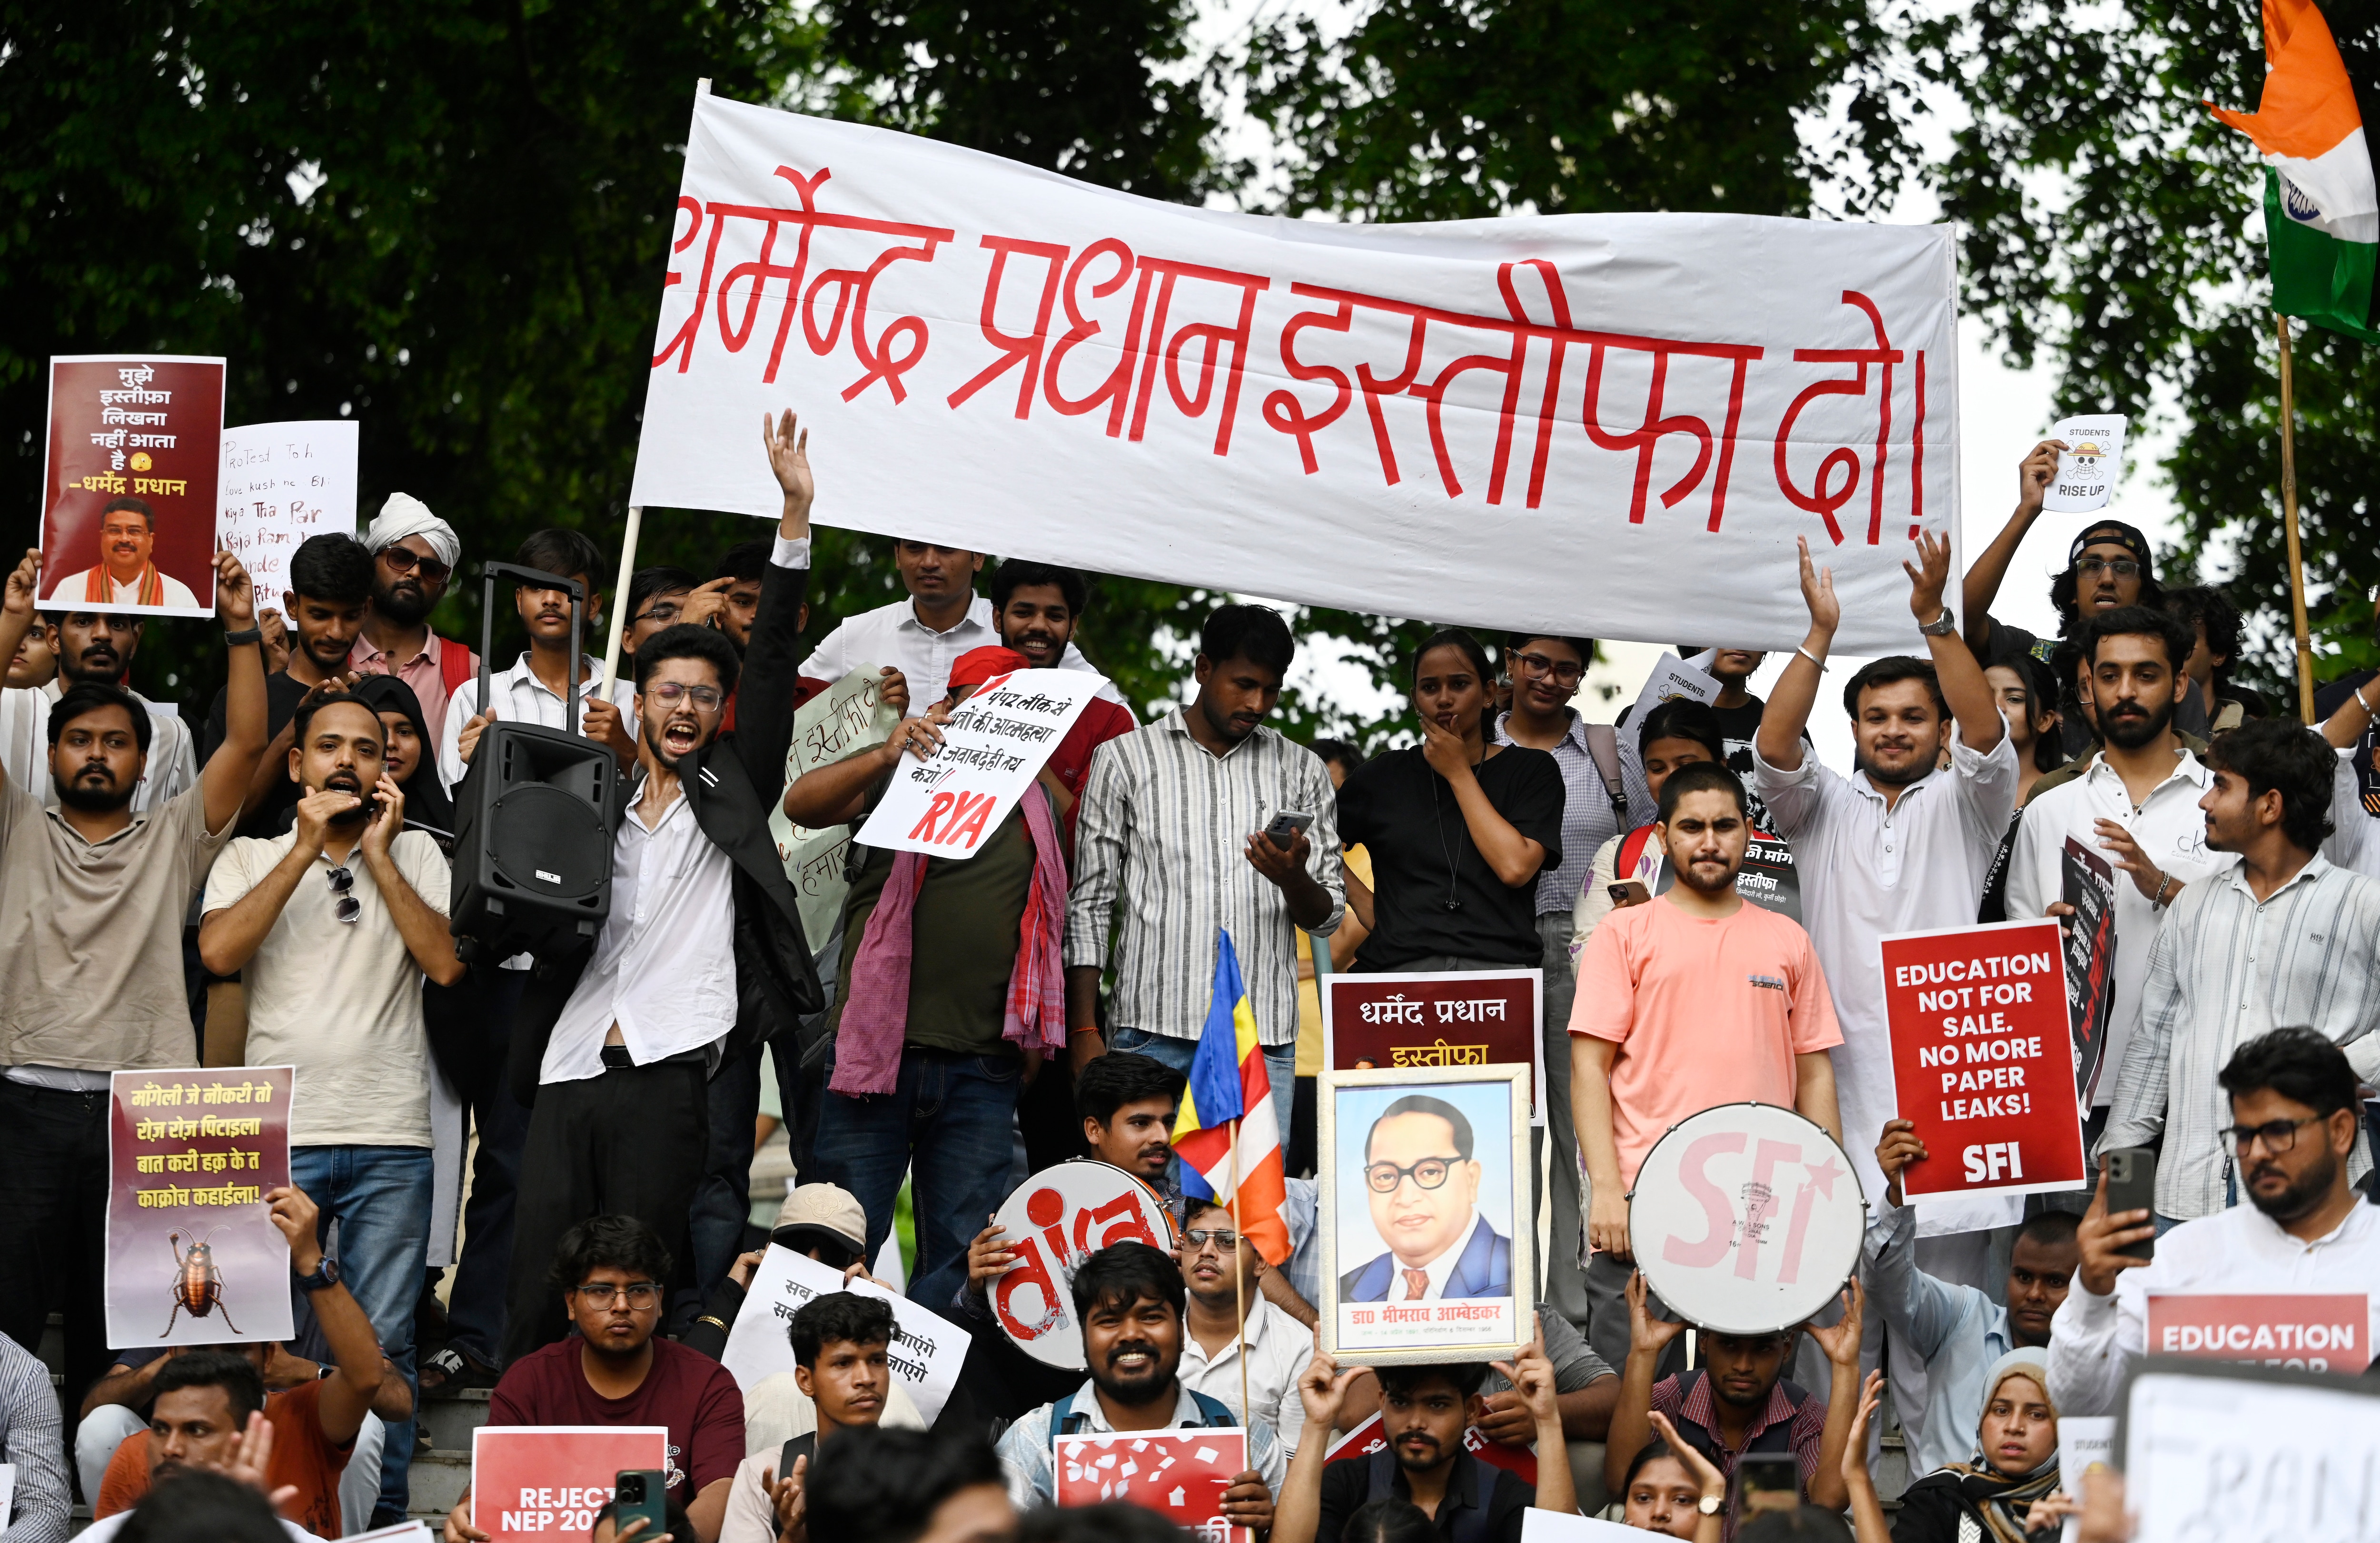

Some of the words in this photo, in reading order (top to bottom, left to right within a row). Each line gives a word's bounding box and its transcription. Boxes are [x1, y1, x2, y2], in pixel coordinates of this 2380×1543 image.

[947, 238, 1270, 457] प्रधान
[119, 365, 154, 387] मुझे
[100, 386, 171, 406] इस्तीफ़ा
[101, 407, 167, 425] लिखना
[90, 429, 128, 448] नहीं
[129, 434, 177, 448] आता
[110, 450, 126, 470] है
[134, 477, 187, 496] प्रधान
[2059, 485, 2087, 496] RISE
[2089, 485, 2104, 496] UP
[252, 502, 277, 518] Tha
[290, 501, 322, 524] Par
[258, 527, 290, 545] Ram
[1669, 673, 1705, 697] STUDENTS
[972, 711, 994, 733] की
[908, 790, 997, 850] RYA
[1737, 872, 1778, 891] इस्तीफा
[1895, 952, 2050, 987] EDUCATION
[1919, 988, 1973, 1012] NOT
[1980, 982, 2032, 1008] FOR
[1434, 999, 1507, 1023] प्रधान
[1943, 1012, 2013, 1037] SALE.
[1920, 1045, 1959, 1067] NO
[1965, 1037, 2042, 1063] MORE
[1941, 1066, 2025, 1093] PAPER
[131, 1081, 184, 1107] माँगेली
[185, 1083, 201, 1105] जे
[202, 1081, 254, 1104] नौकरी
[255, 1081, 273, 1103] तो
[1941, 1093, 2031, 1121] LEAKS!
[136, 1117, 167, 1142] रोज़
[168, 1115, 199, 1141] रोज़
[200, 1115, 262, 1138] पिटाइला
[136, 1155, 165, 1173] बात
[166, 1148, 199, 1172] करी
[200, 1152, 228, 1174] हक़
[228, 1147, 246, 1170] के
[247, 1151, 260, 1169] त
[1962, 1141, 2023, 1182] SFI
[136, 1183, 191, 1208] काक्रोच
[191, 1181, 260, 1207] कहाईला!
[786, 1279, 813, 1300] सब
[1383, 1306, 1430, 1323] भीमराव
[1438, 1303, 1501, 1321] आम्बेडकर
[2162, 1323, 2354, 1352] EDUCATION
[502, 1511, 554, 1531] NEP
